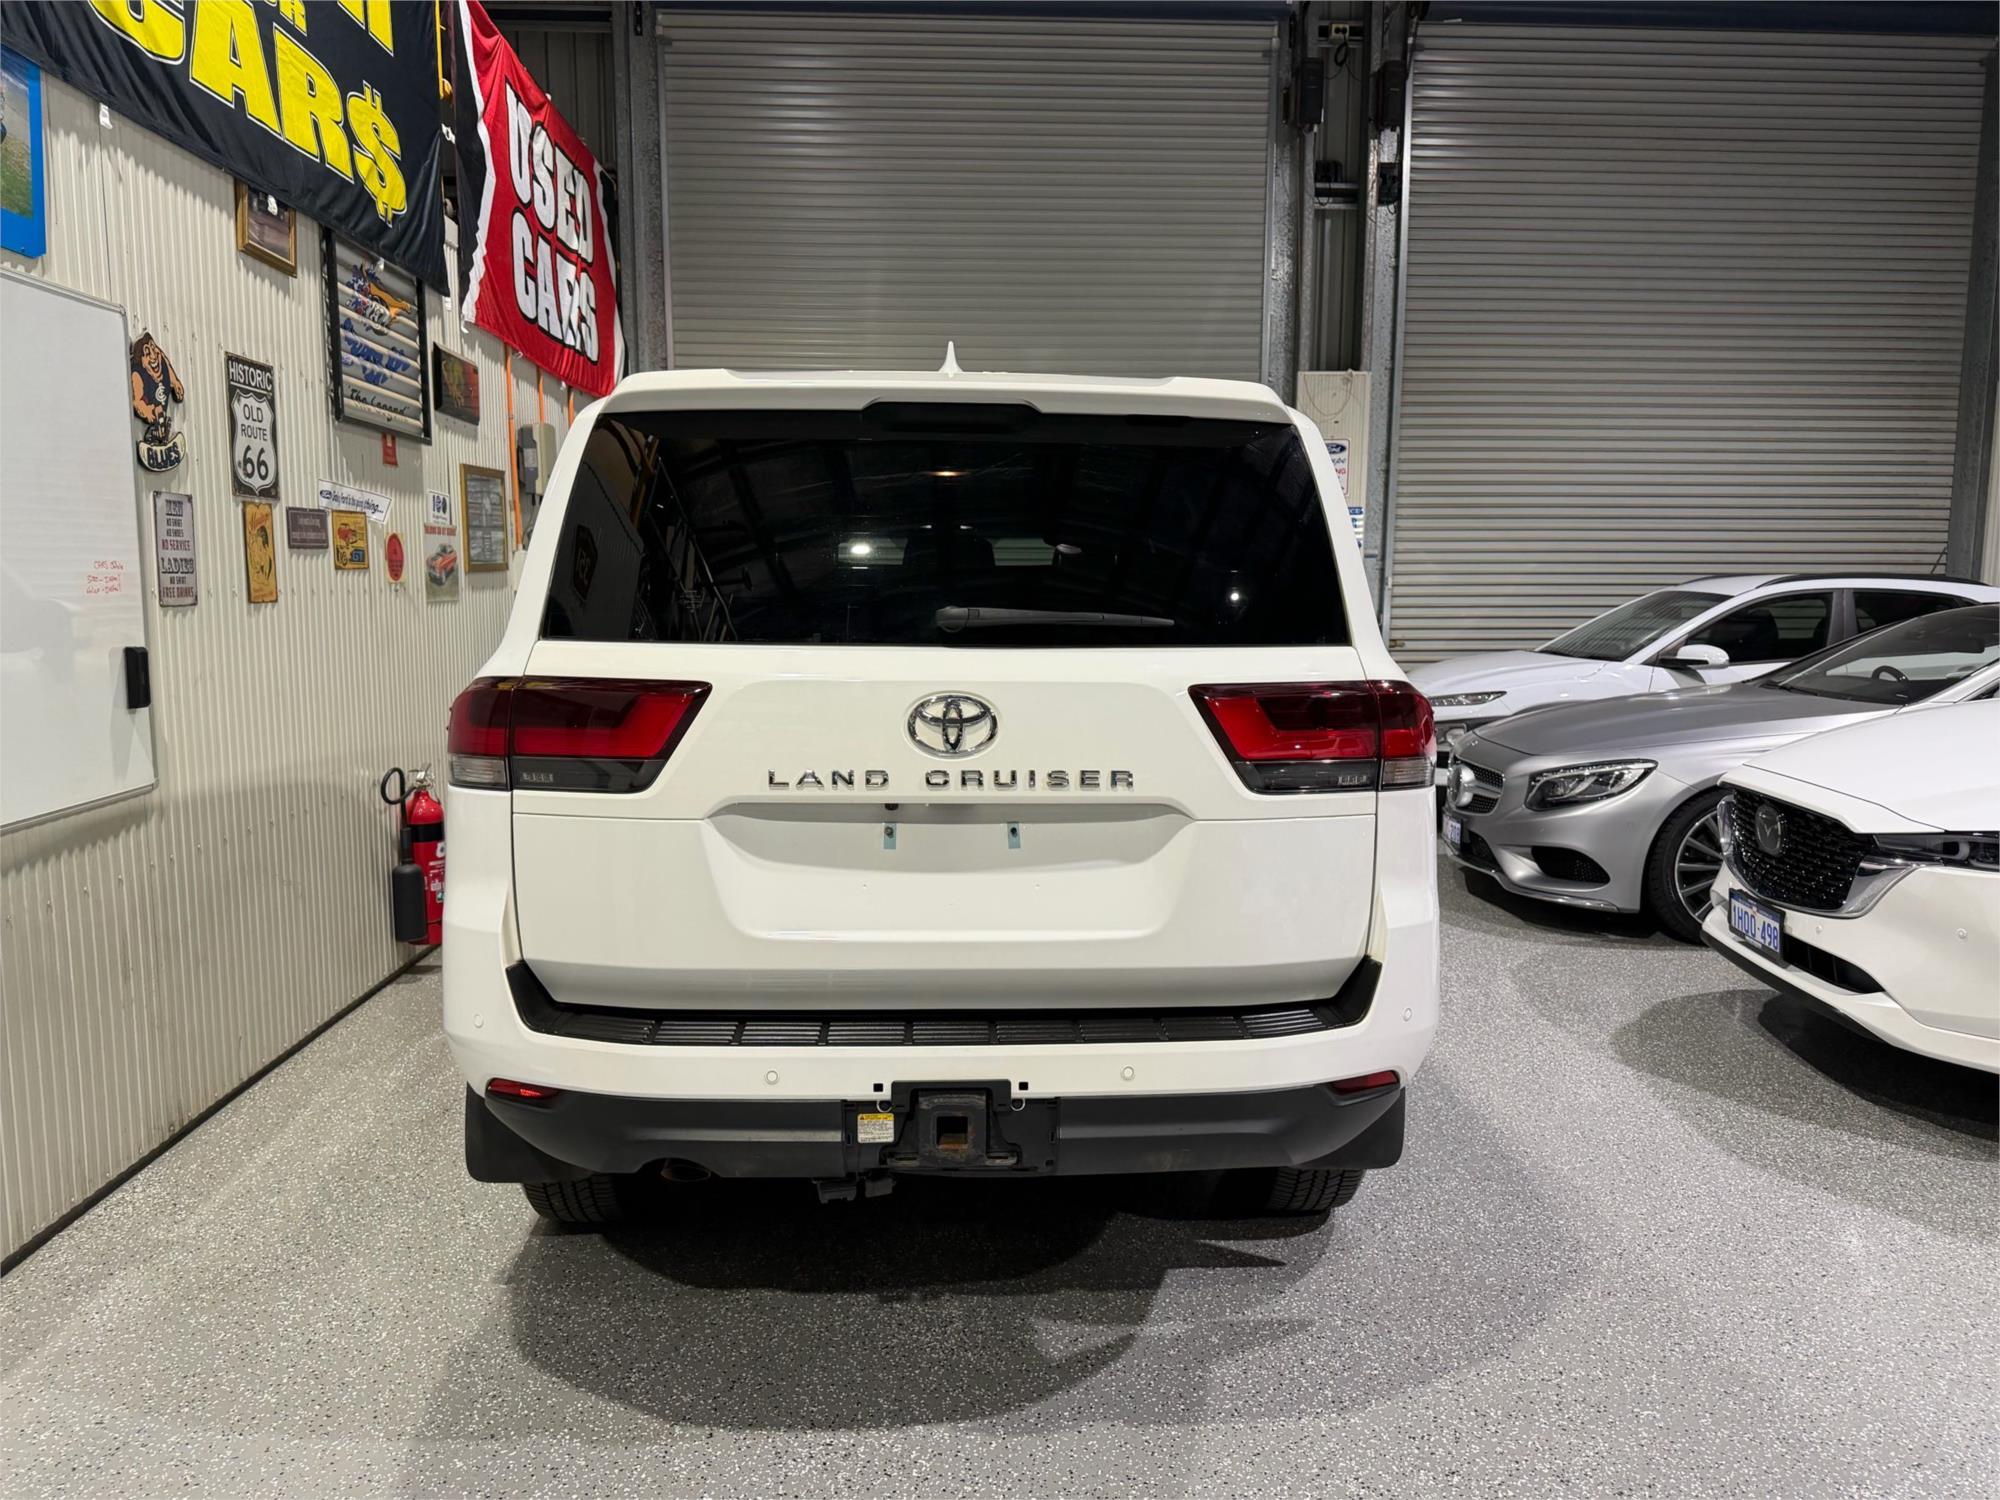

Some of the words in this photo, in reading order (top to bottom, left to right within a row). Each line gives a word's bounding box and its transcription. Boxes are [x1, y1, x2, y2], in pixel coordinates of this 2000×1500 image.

[505, 80, 593, 265] USED
[511, 206, 600, 365] CARS
[228, 360, 273, 391] HISTORIC
[242, 403, 264, 423] OLD
[240, 423, 268, 442] ROUTE
[146, 441, 181, 470] BLUES
[242, 444, 269, 481] 66
[161, 539, 169, 551] NO
[170, 540, 191, 552] SERVICE
[160, 557, 195, 574] LADIES
[767, 768, 890, 791] LAND
[925, 768, 1135, 791] CRUISER
